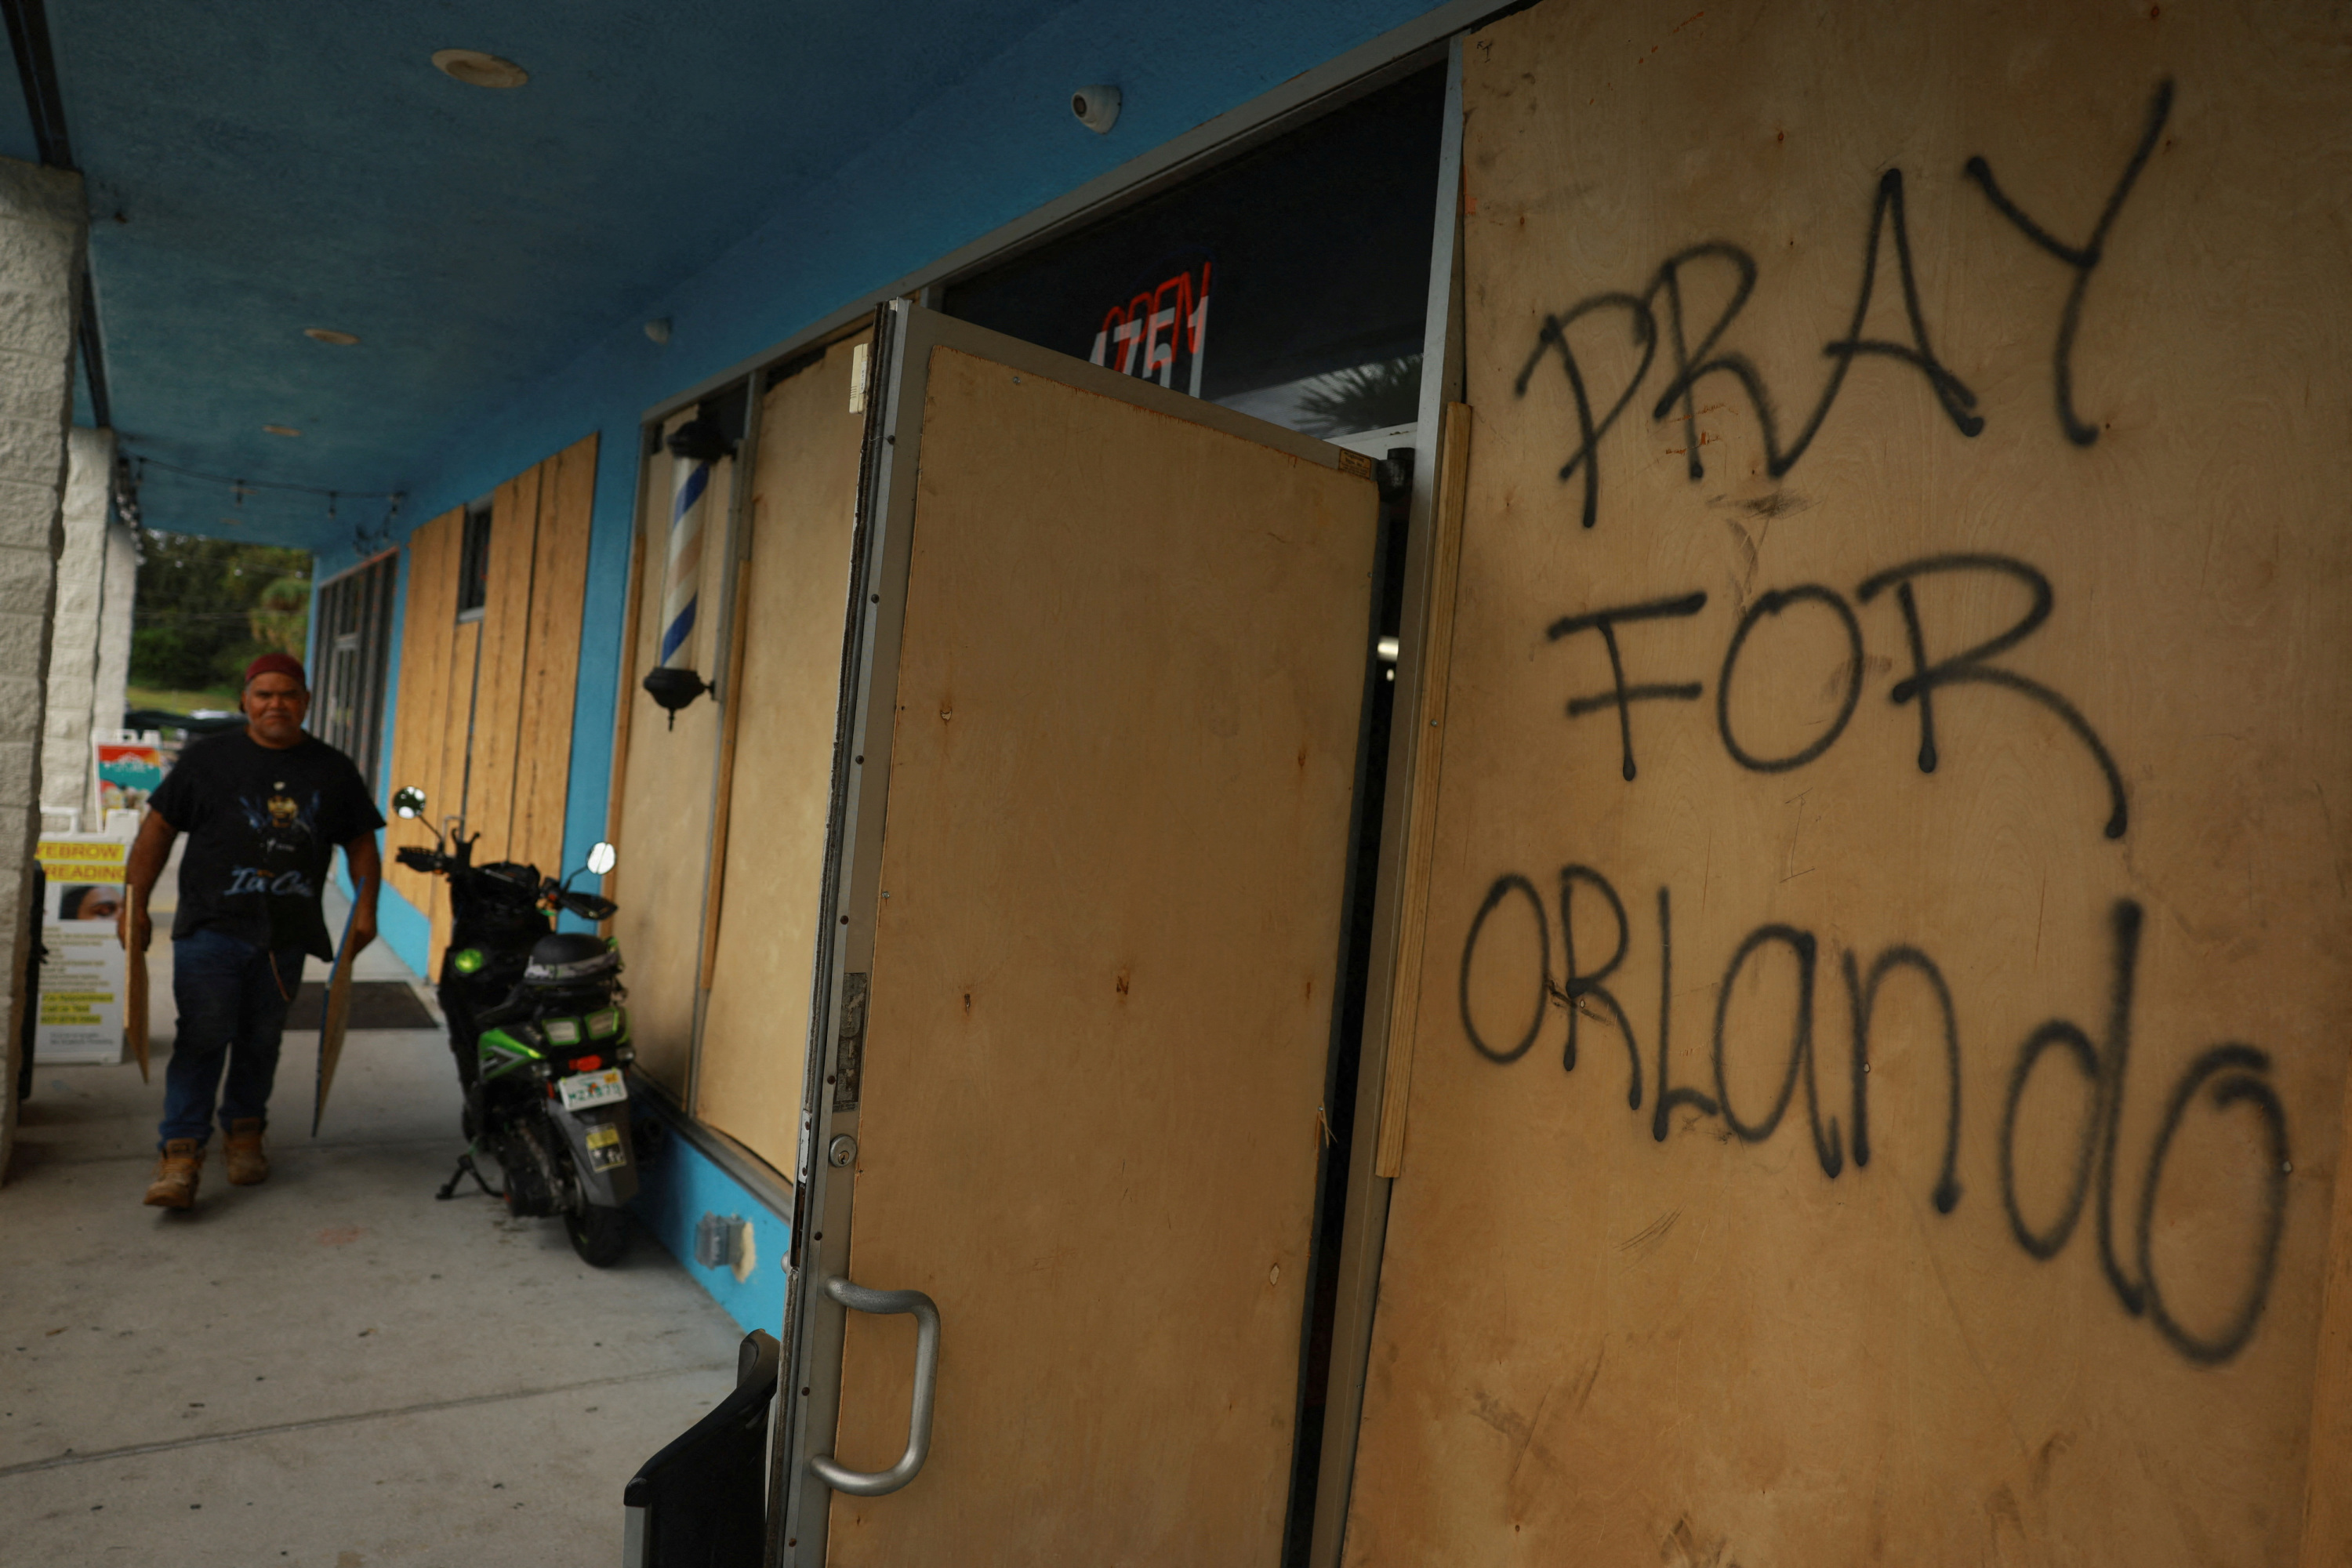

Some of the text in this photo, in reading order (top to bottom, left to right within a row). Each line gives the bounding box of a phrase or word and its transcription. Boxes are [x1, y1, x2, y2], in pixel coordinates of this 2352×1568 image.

[1099, 260, 1211, 373] OPEN
[1515, 72, 2176, 528] PRAY
[1547, 552, 2128, 839] FOR
